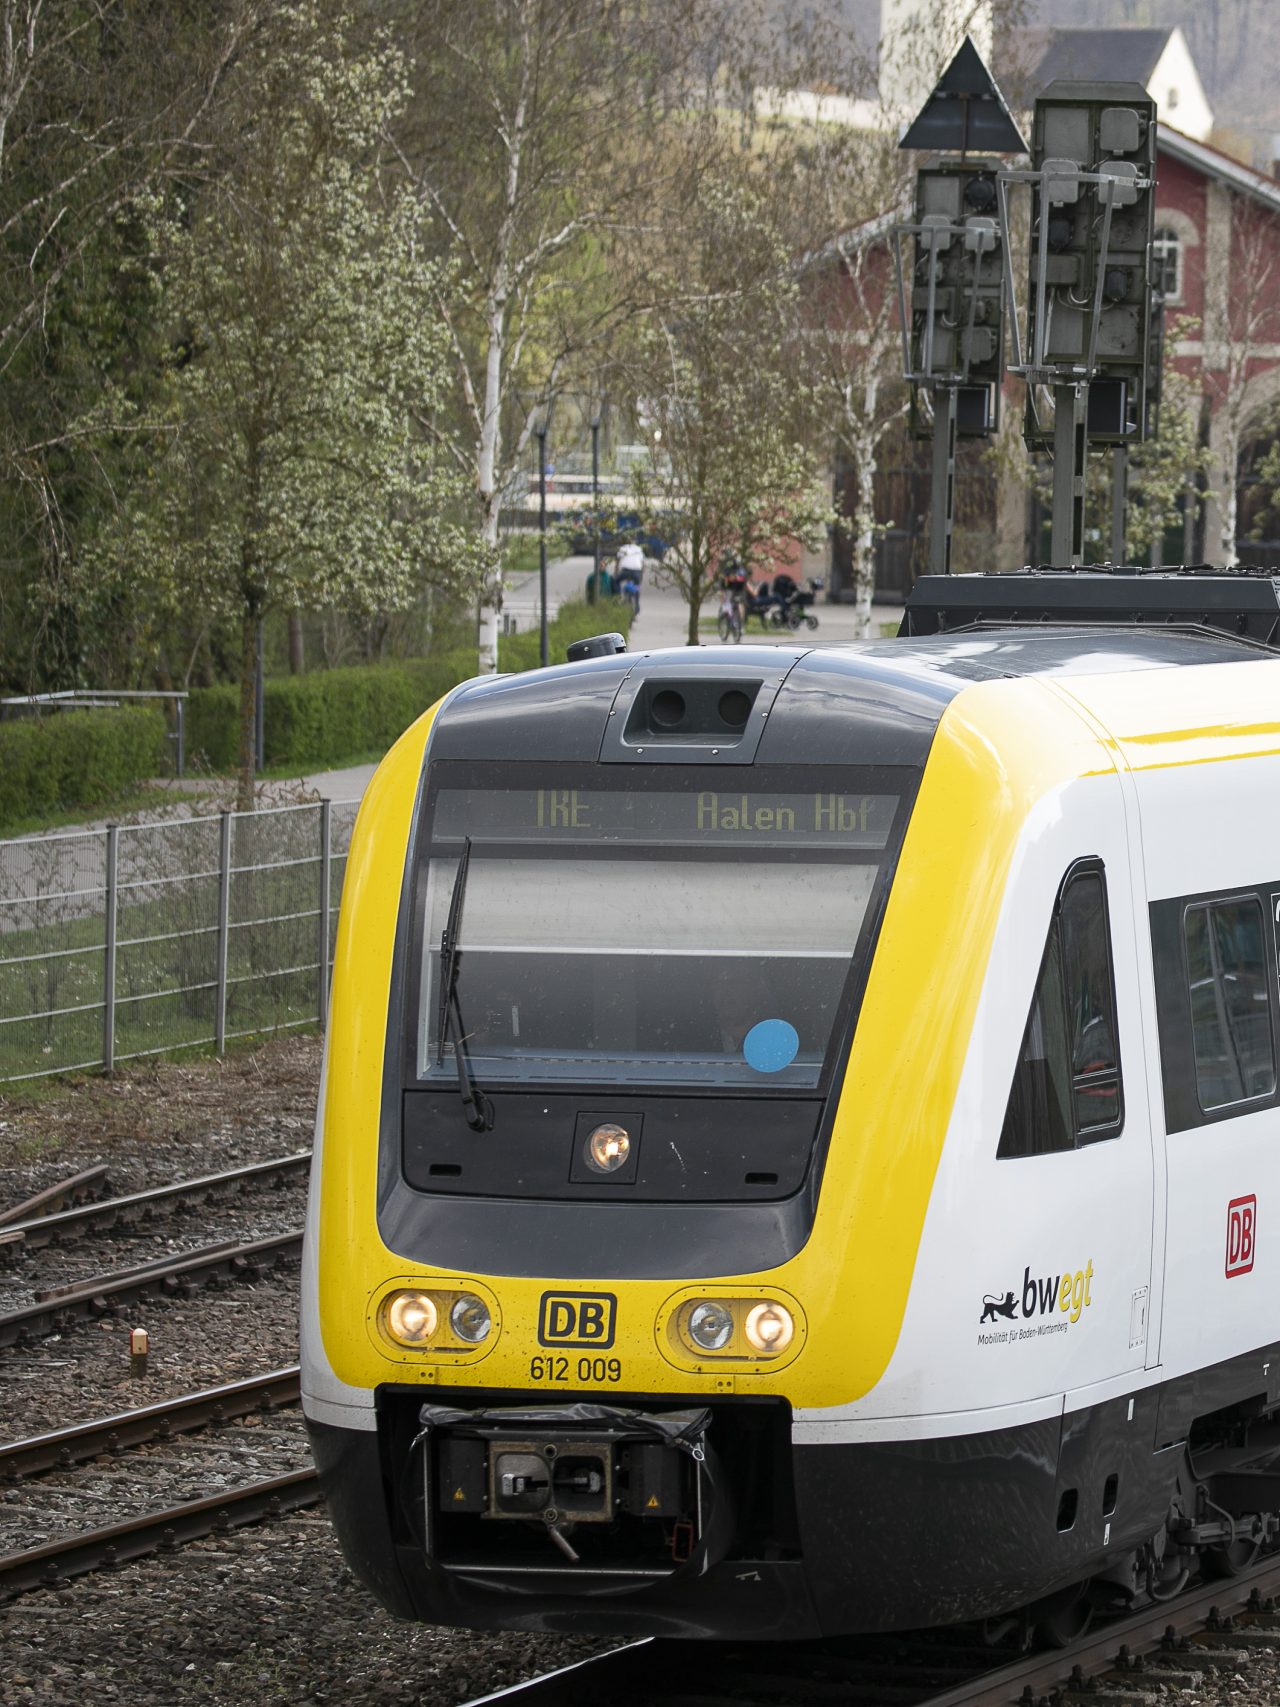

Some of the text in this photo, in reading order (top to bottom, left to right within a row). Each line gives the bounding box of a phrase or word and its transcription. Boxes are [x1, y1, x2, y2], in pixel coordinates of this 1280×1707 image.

[697, 791, 874, 832] Aalen Hbf
[1229, 1207, 1253, 1265] DB
[1022, 1259, 1094, 1323] bwegt
[548, 1301, 604, 1338] DB
[977, 1322, 1068, 1345] Mobilität für Baden-Württemberg
[530, 1356, 622, 1382] 612 009
